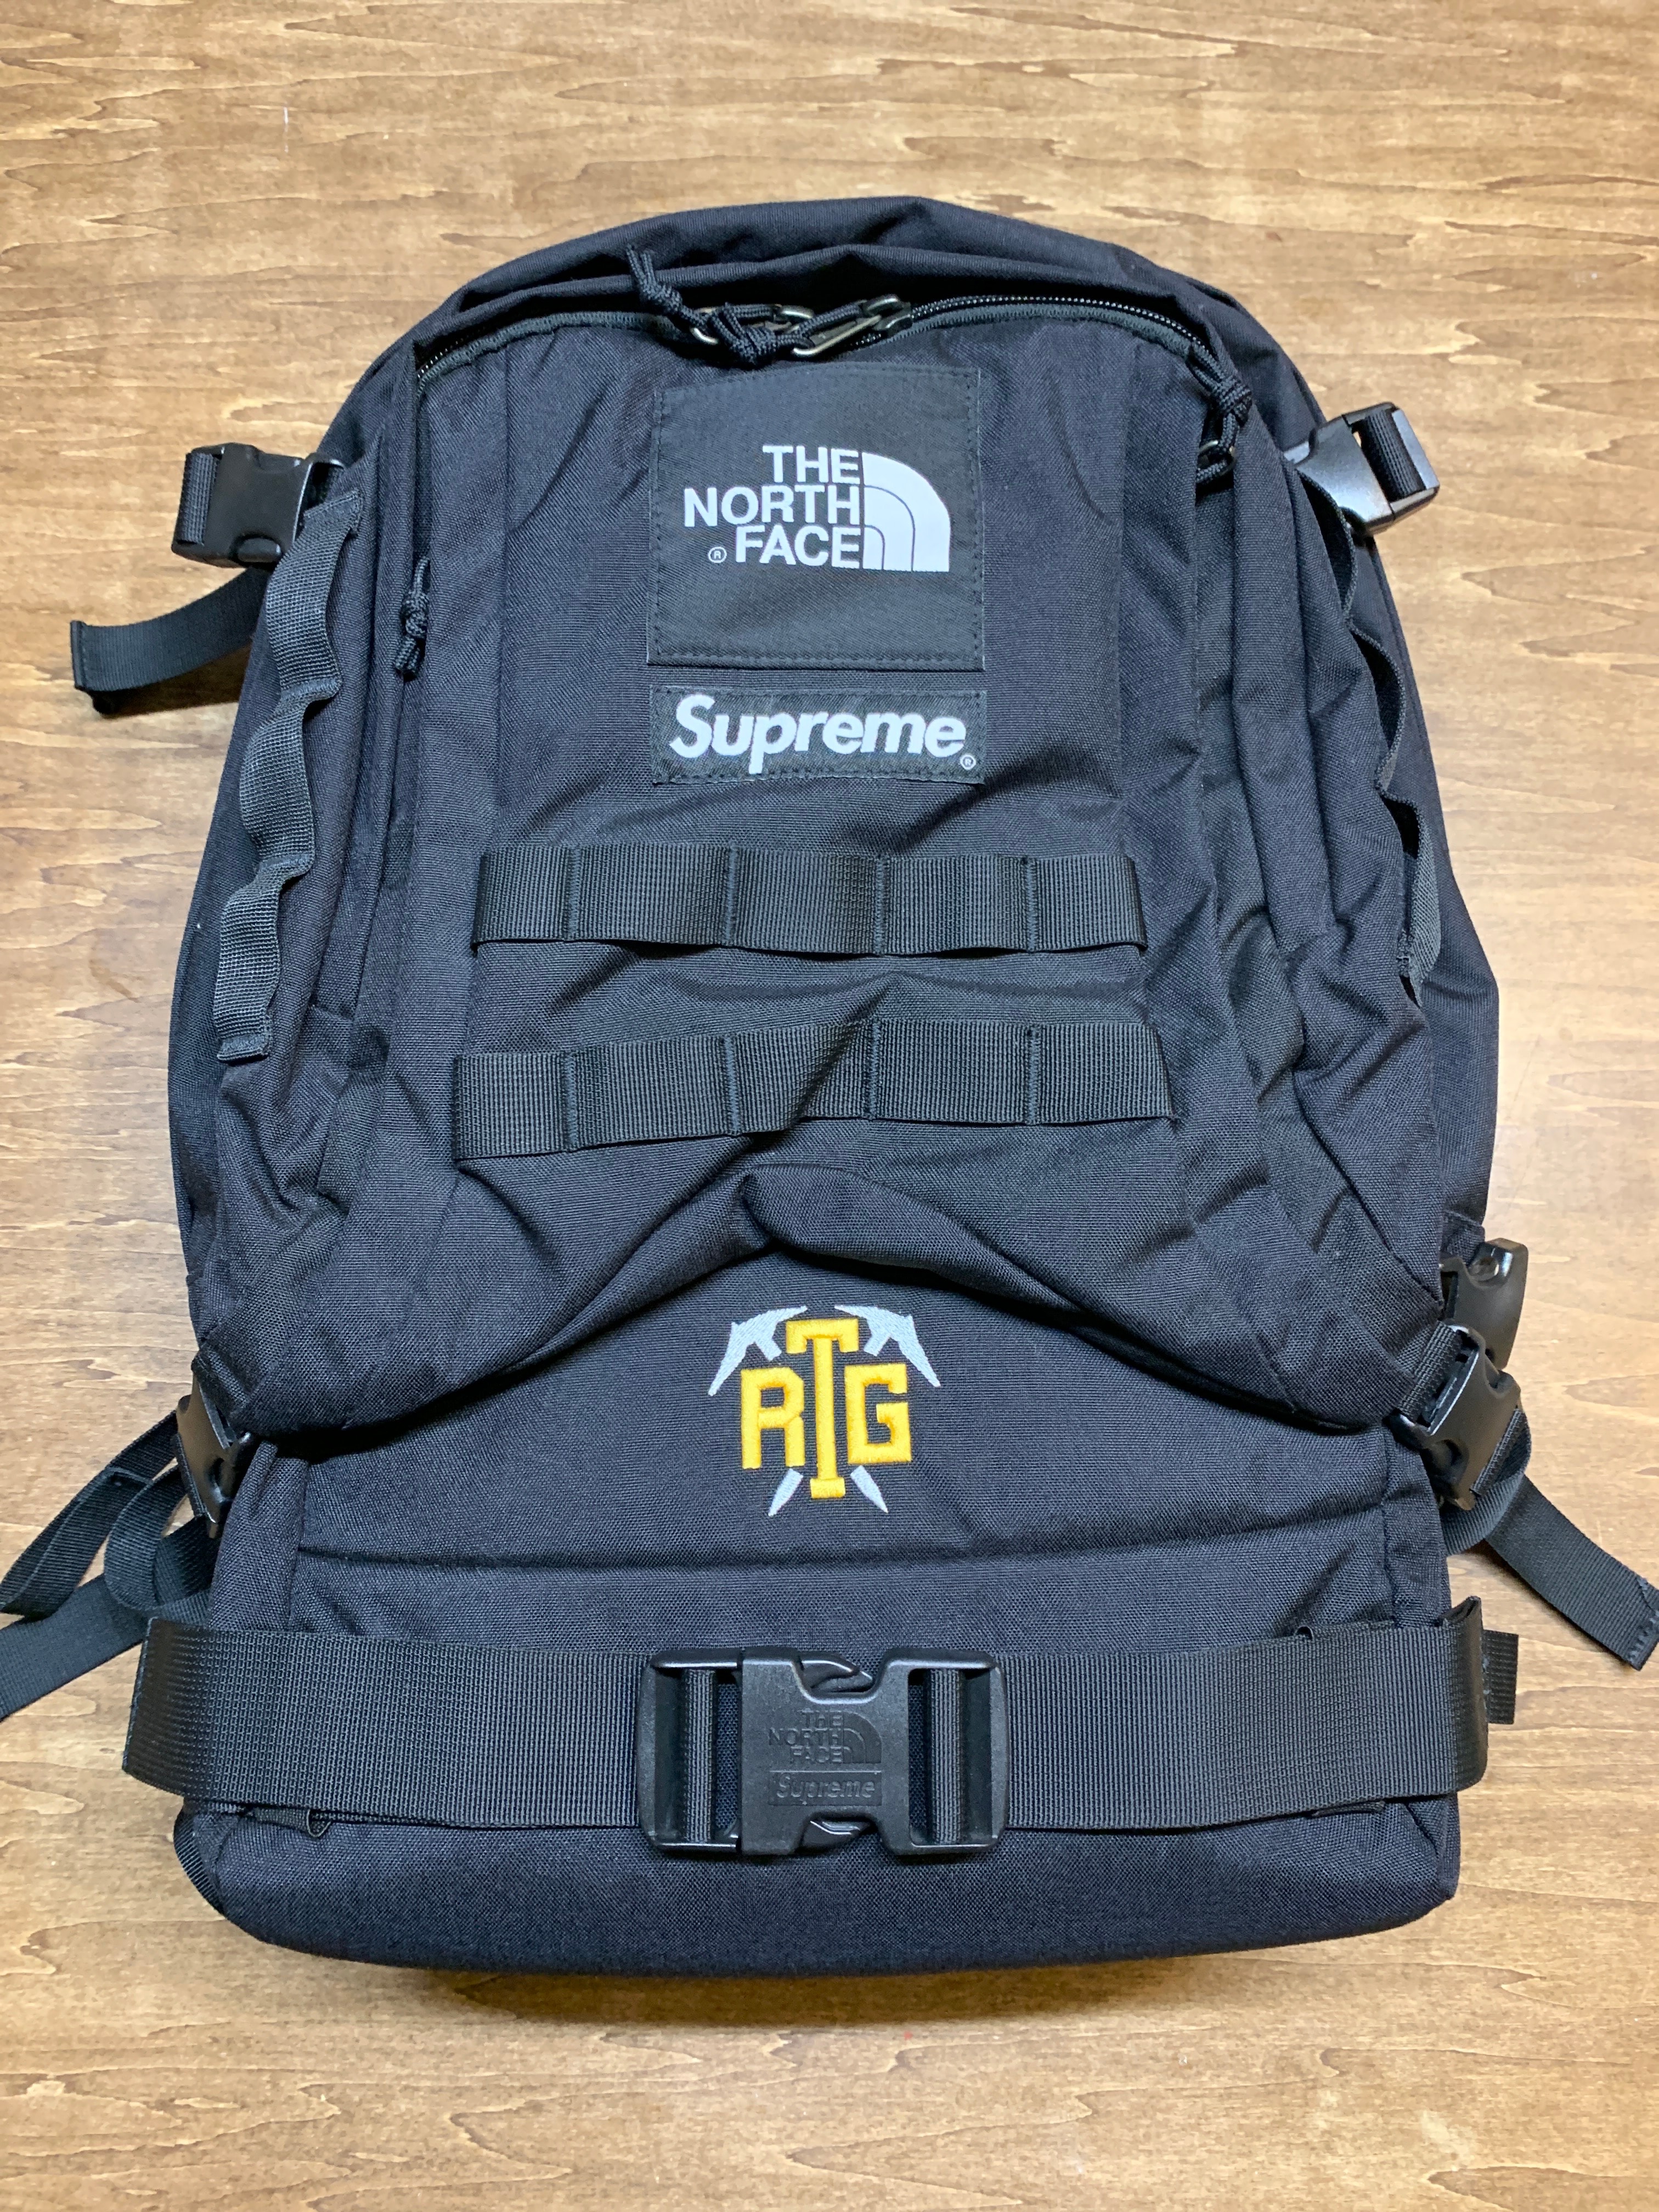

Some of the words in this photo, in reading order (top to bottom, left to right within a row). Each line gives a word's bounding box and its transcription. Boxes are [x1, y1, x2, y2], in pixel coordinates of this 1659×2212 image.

[763, 445, 861, 483] THE
[684, 484, 861, 527] NORTH
[735, 525, 861, 568] FACE
[669, 693, 966, 774] Supreme
[777, 1774, 875, 1805] Supreme
